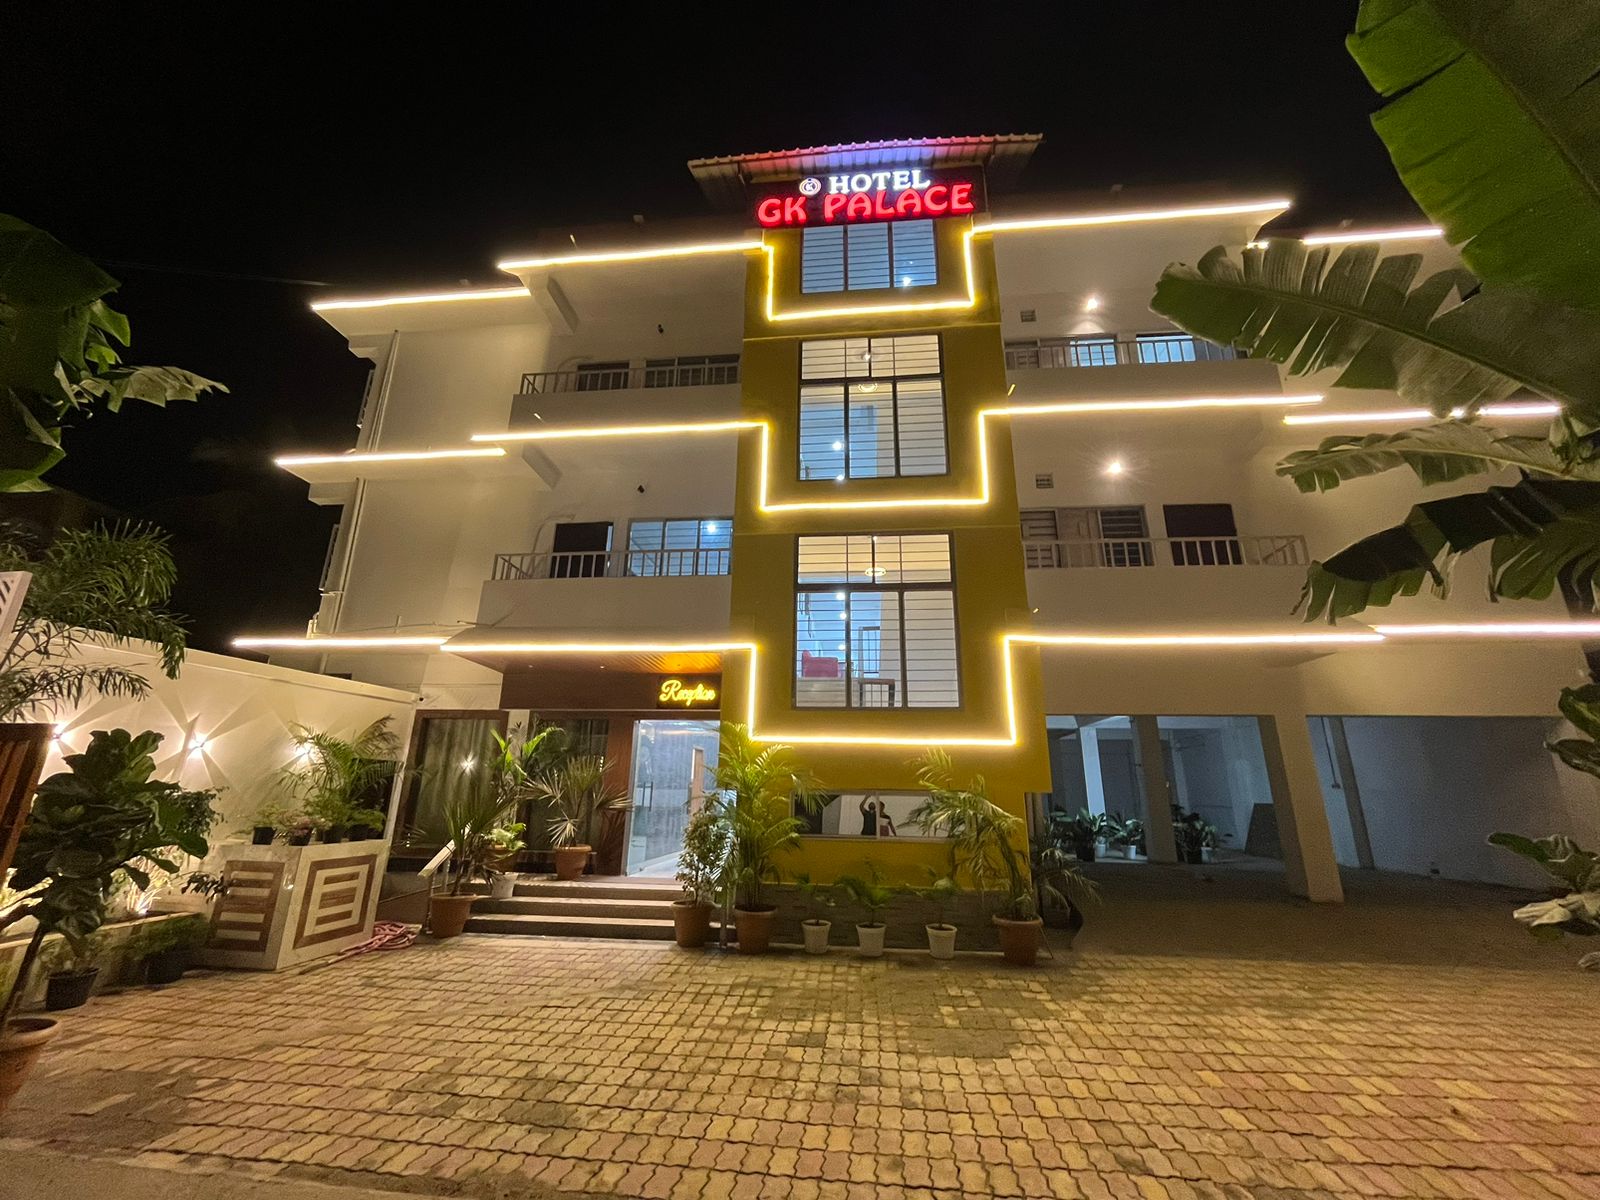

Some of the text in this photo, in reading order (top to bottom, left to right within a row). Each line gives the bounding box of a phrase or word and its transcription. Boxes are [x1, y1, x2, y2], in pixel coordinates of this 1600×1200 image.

[828, 169, 931, 194] HOTEL
[757, 183, 974, 227] GK PALACE
